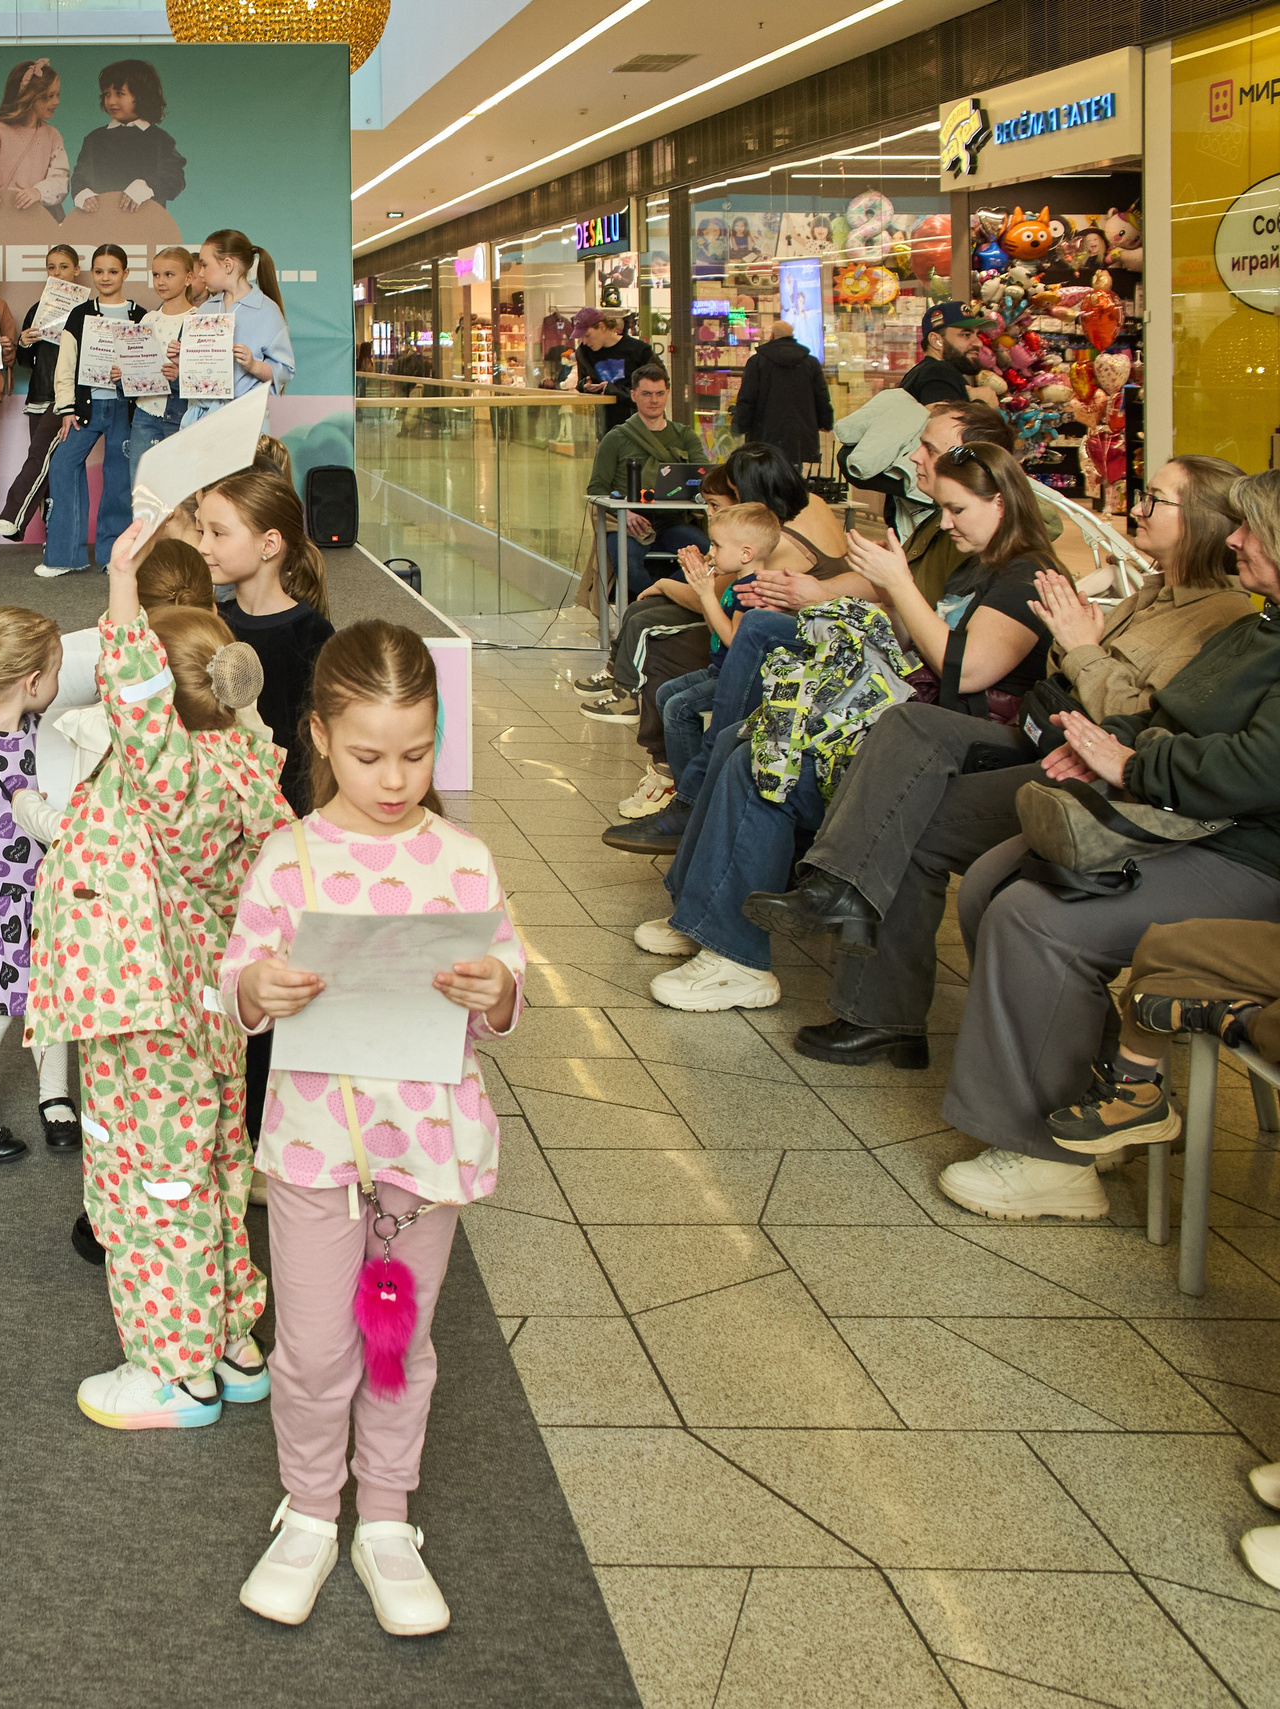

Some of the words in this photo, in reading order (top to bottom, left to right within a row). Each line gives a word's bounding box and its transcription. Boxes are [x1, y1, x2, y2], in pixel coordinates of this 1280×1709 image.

[994, 110, 1060, 146] ВЕСЁЛАЯ
[1061, 92, 1115, 130] ЗАТЕЯ
[575, 212, 620, 250] DESALU
